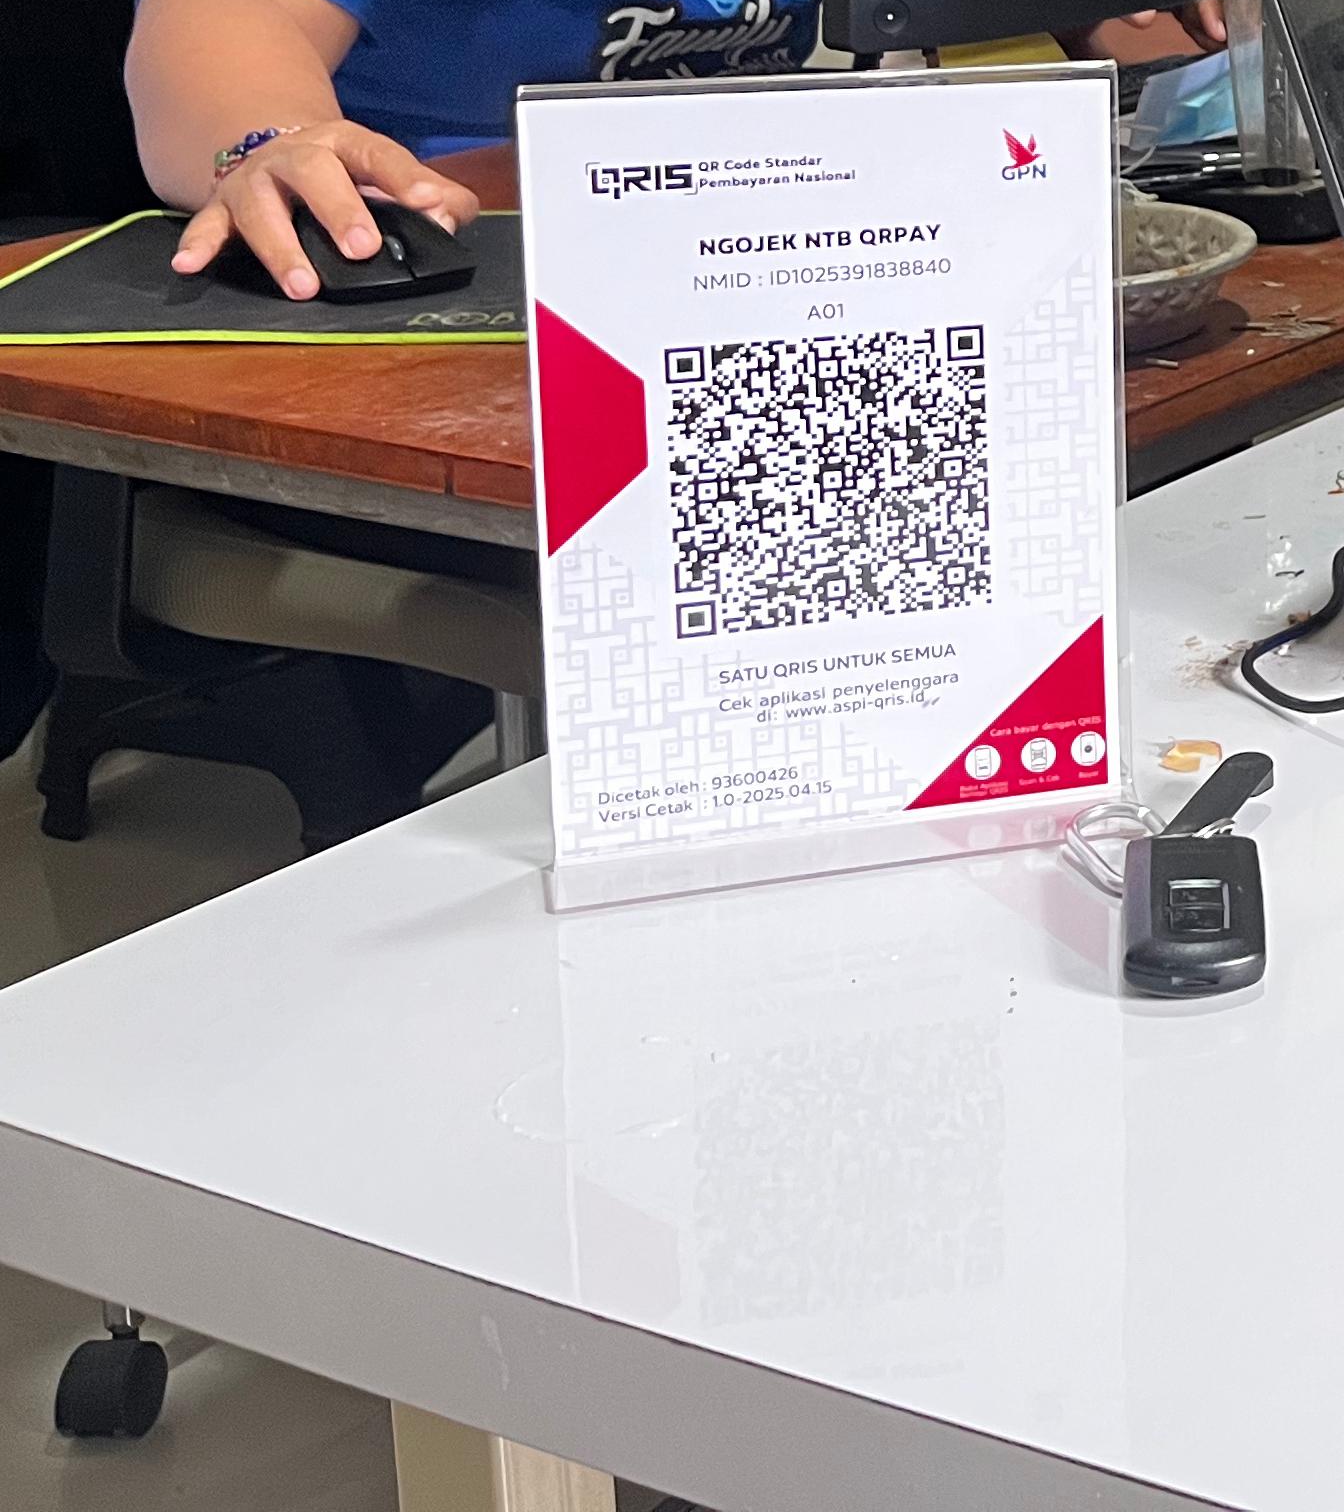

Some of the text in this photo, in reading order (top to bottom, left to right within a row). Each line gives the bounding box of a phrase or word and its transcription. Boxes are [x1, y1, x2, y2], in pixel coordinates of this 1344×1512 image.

[699, 155, 823, 172] QR Code Standar
[699, 169, 856, 189] Pembayaran Nasional
[1001, 162, 1047, 181] GPN
[590, 163, 694, 199] QRIS
[699, 223, 942, 256] NGOJEK NTB QRPAY
[693, 273, 752, 292] NMID
[770, 257, 952, 287] ID1025391838840
[807, 303, 846, 321] A01
[719, 643, 957, 685] SATU QRIS UNTUK SEMUA
[719, 672, 959, 712] Cek aplikasi penyelenggara
[757, 690, 925, 723] di: www.aspi-qris.id
[990, 727, 1012, 738] Cara
[598, 785, 661, 805] Dicetak
[711, 766, 798, 790] 93600426
[598, 806, 641, 823] Versi
[645, 800, 693, 818] Cetak
